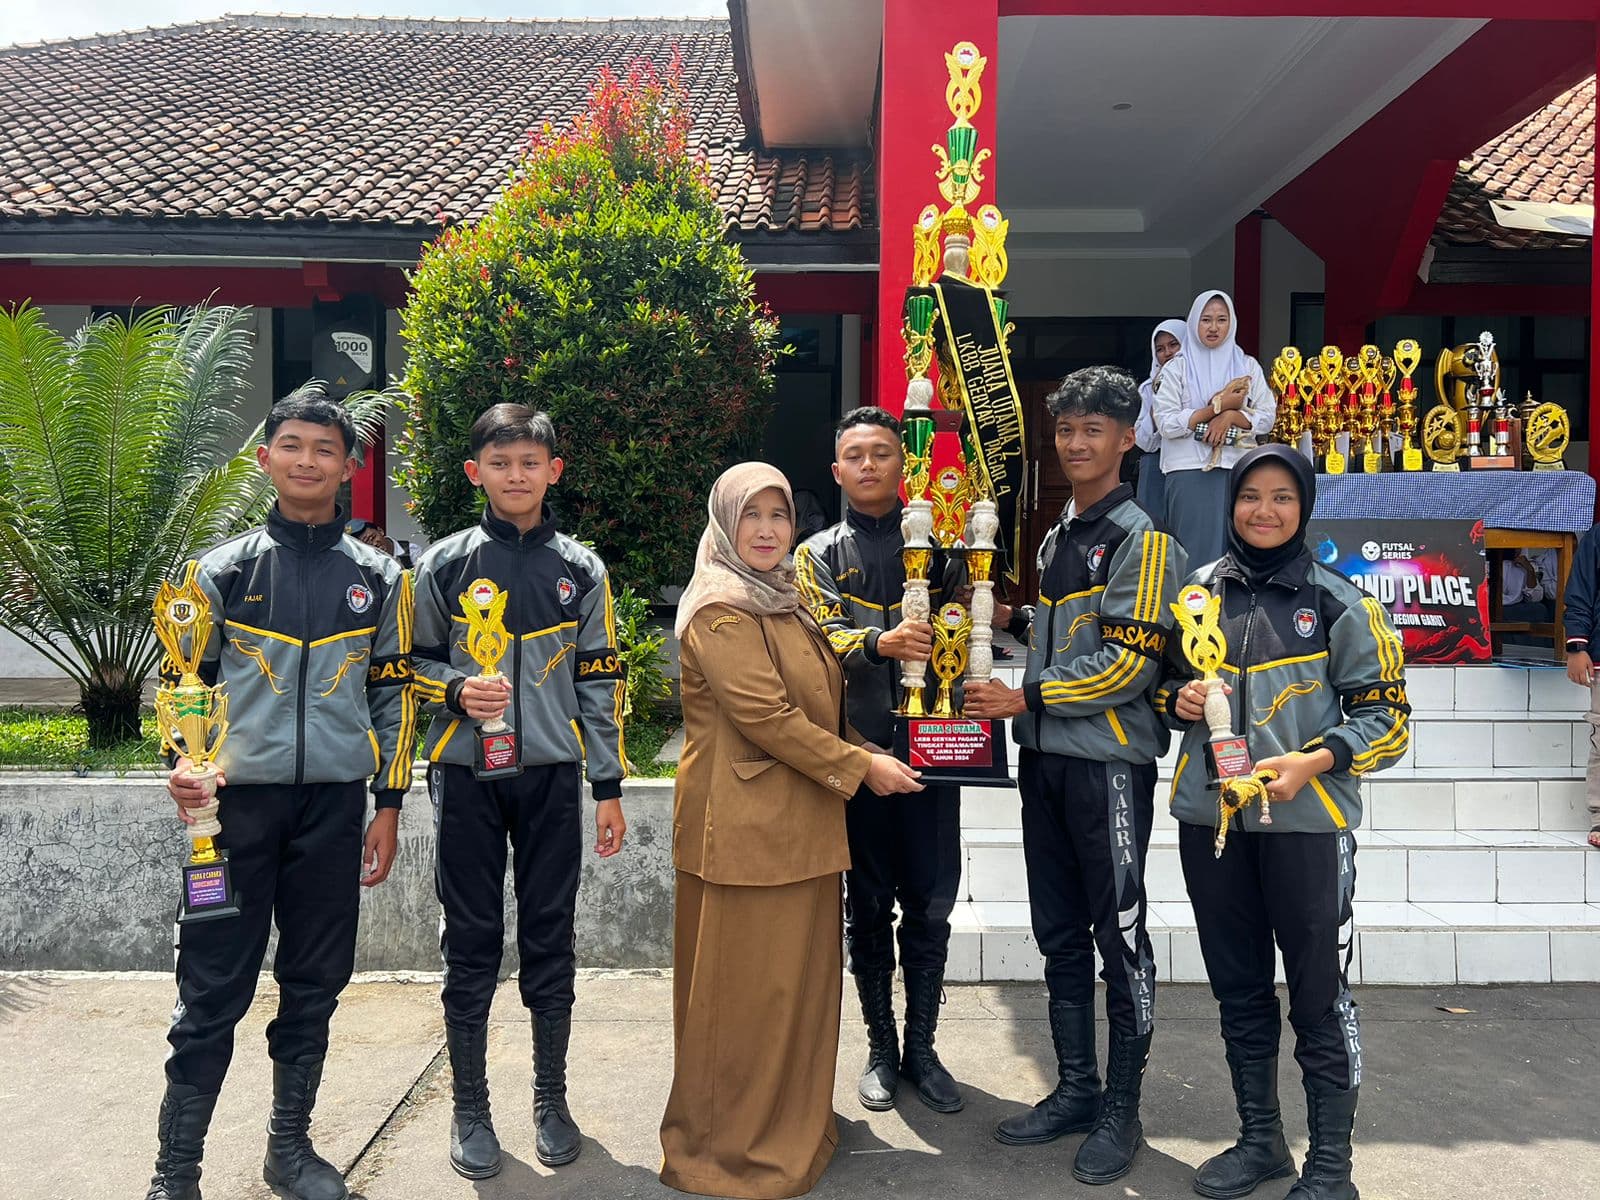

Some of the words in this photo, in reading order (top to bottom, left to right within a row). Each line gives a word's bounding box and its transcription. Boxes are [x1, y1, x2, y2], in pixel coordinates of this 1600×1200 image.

[336, 341, 368, 352] 1000
[956, 332, 981, 372] LKBB
[976, 343, 1008, 394] JUARA
[967, 376, 996, 430] GEBYAR
[991, 395, 1021, 445] UTAMA
[983, 439, 1008, 484] PAGAR
[1382, 543, 1415, 551] FUTSAL
[1382, 552, 1412, 560] SERIES
[1402, 575, 1476, 607] PLACE
[1393, 613, 1421, 626] REGION
[918, 724, 945, 734] JUARA
[952, 724, 982, 734] UTAMA
[1112, 774, 1133, 866] CAKRA
